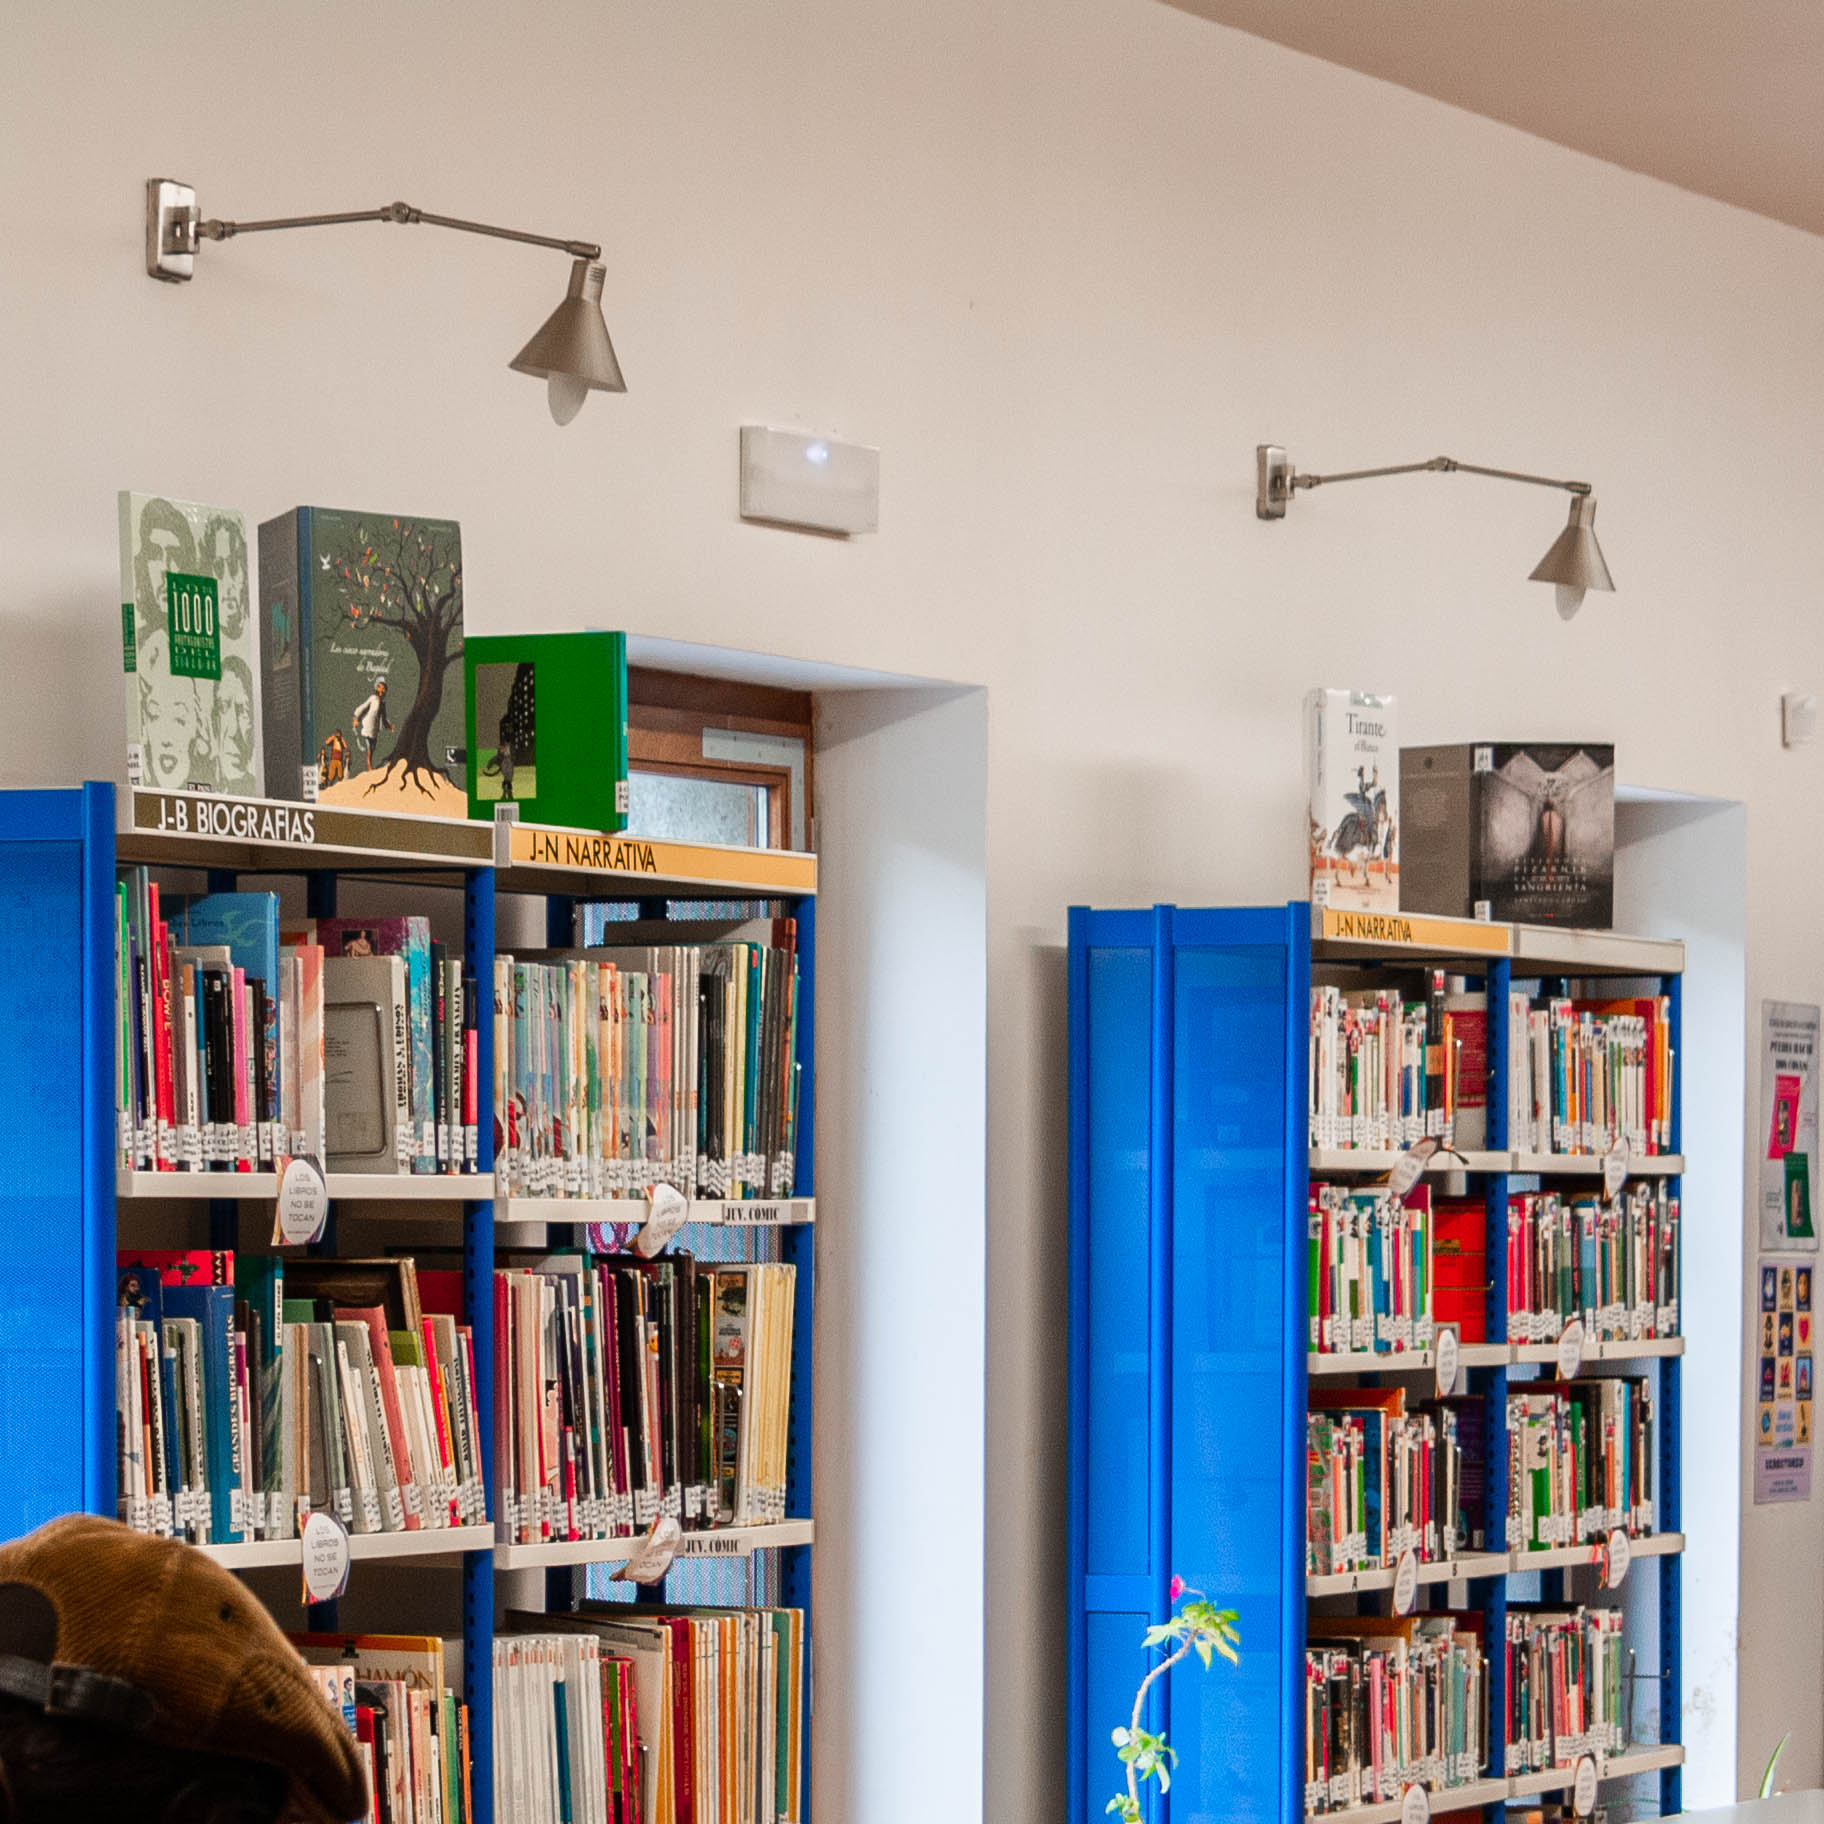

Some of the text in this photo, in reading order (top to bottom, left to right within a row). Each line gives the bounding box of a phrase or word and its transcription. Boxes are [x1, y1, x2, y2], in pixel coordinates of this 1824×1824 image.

[173, 592, 214, 636] 1000
[1346, 713, 1385, 737] Tirante
[158, 799, 315, 844] J-B BIOGRAFÍAS
[530, 834, 656, 873] J-N NARRATIVA
[1335, 913, 1412, 943] J-N NARRATIVA
[748, 1205, 780, 1221] CÓMIC
[226, 1314, 241, 1474] GRANDES BIOGRAFÍAS
[709, 1536, 738, 1554] CÓMIC
